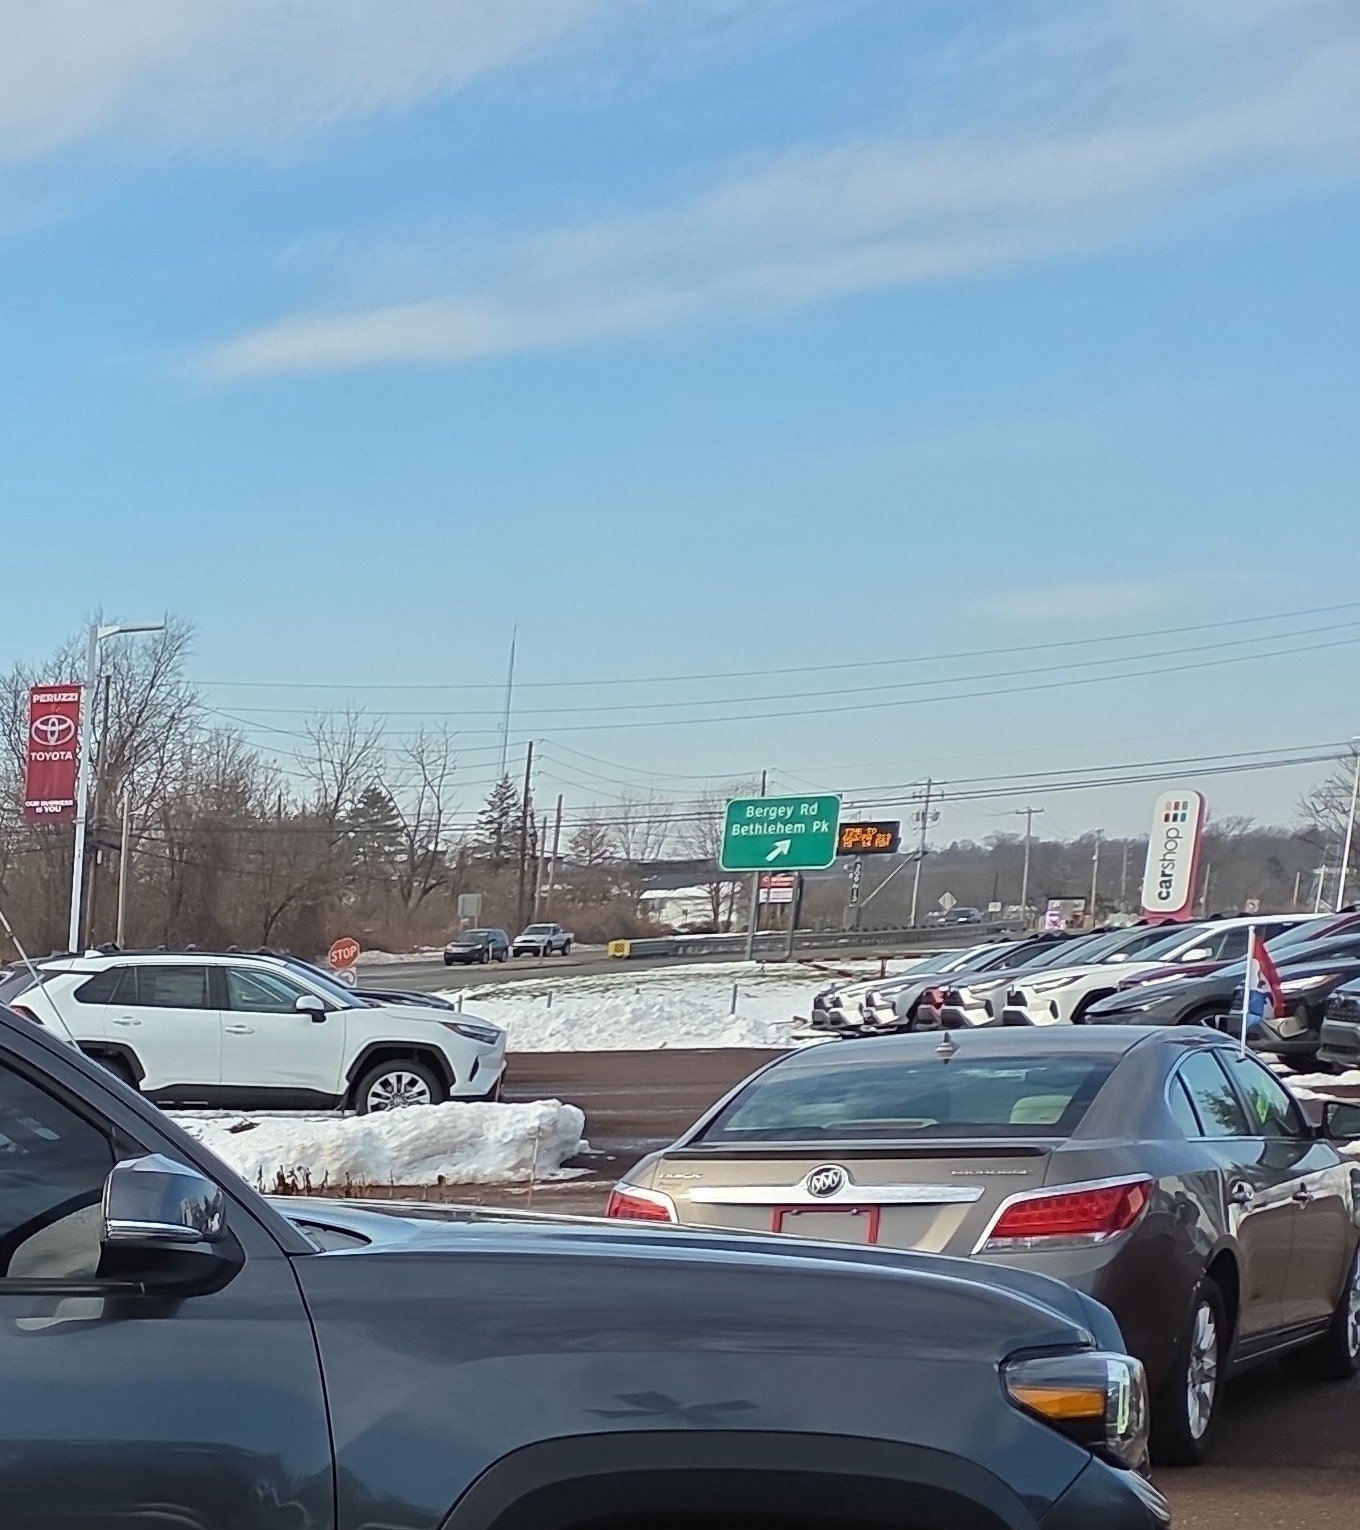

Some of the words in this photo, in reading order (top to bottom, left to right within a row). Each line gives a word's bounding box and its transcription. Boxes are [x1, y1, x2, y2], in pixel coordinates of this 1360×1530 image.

[32, 692, 78, 703] PERUZZI
[30, 751, 73, 761] TOYOTA
[746, 804, 794, 820] Bergey
[800, 802, 818, 815] Rd
[732, 822, 806, 836] Bethlehem
[812, 820, 829, 833] Pk
[1158, 827, 1183, 900] carshop
[331, 945, 357, 962] STOP
